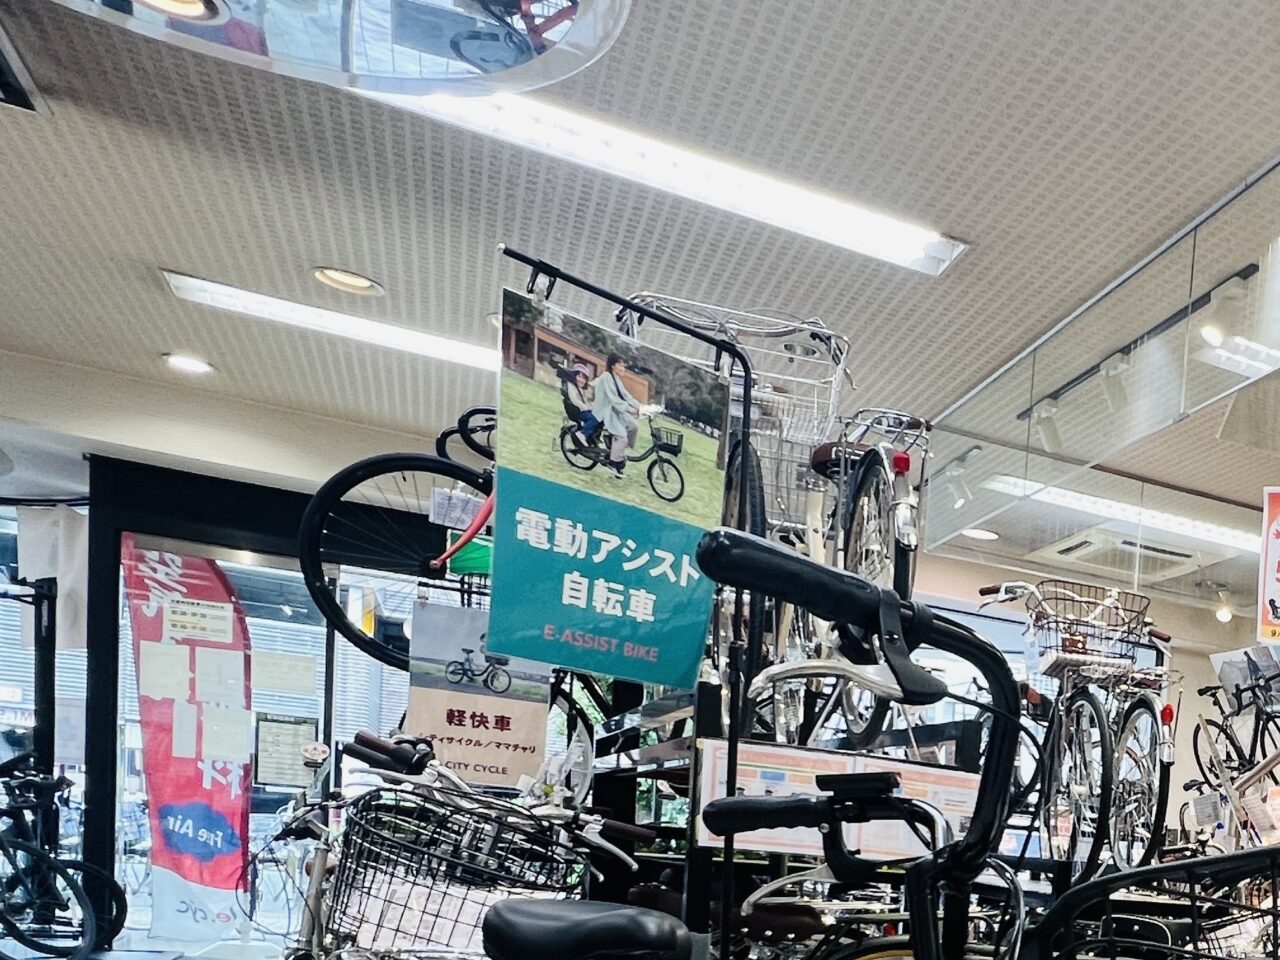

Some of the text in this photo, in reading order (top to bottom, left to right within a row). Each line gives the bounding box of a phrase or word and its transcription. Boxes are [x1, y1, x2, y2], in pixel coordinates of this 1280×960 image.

[515, 507, 700, 587] 電動アシスト
[562, 571, 657, 623] 自転車
[623, 642, 659, 662] BIKE
[446, 708, 512, 732] 軽快車
[444, 760, 508, 775] CITY CYCLE
